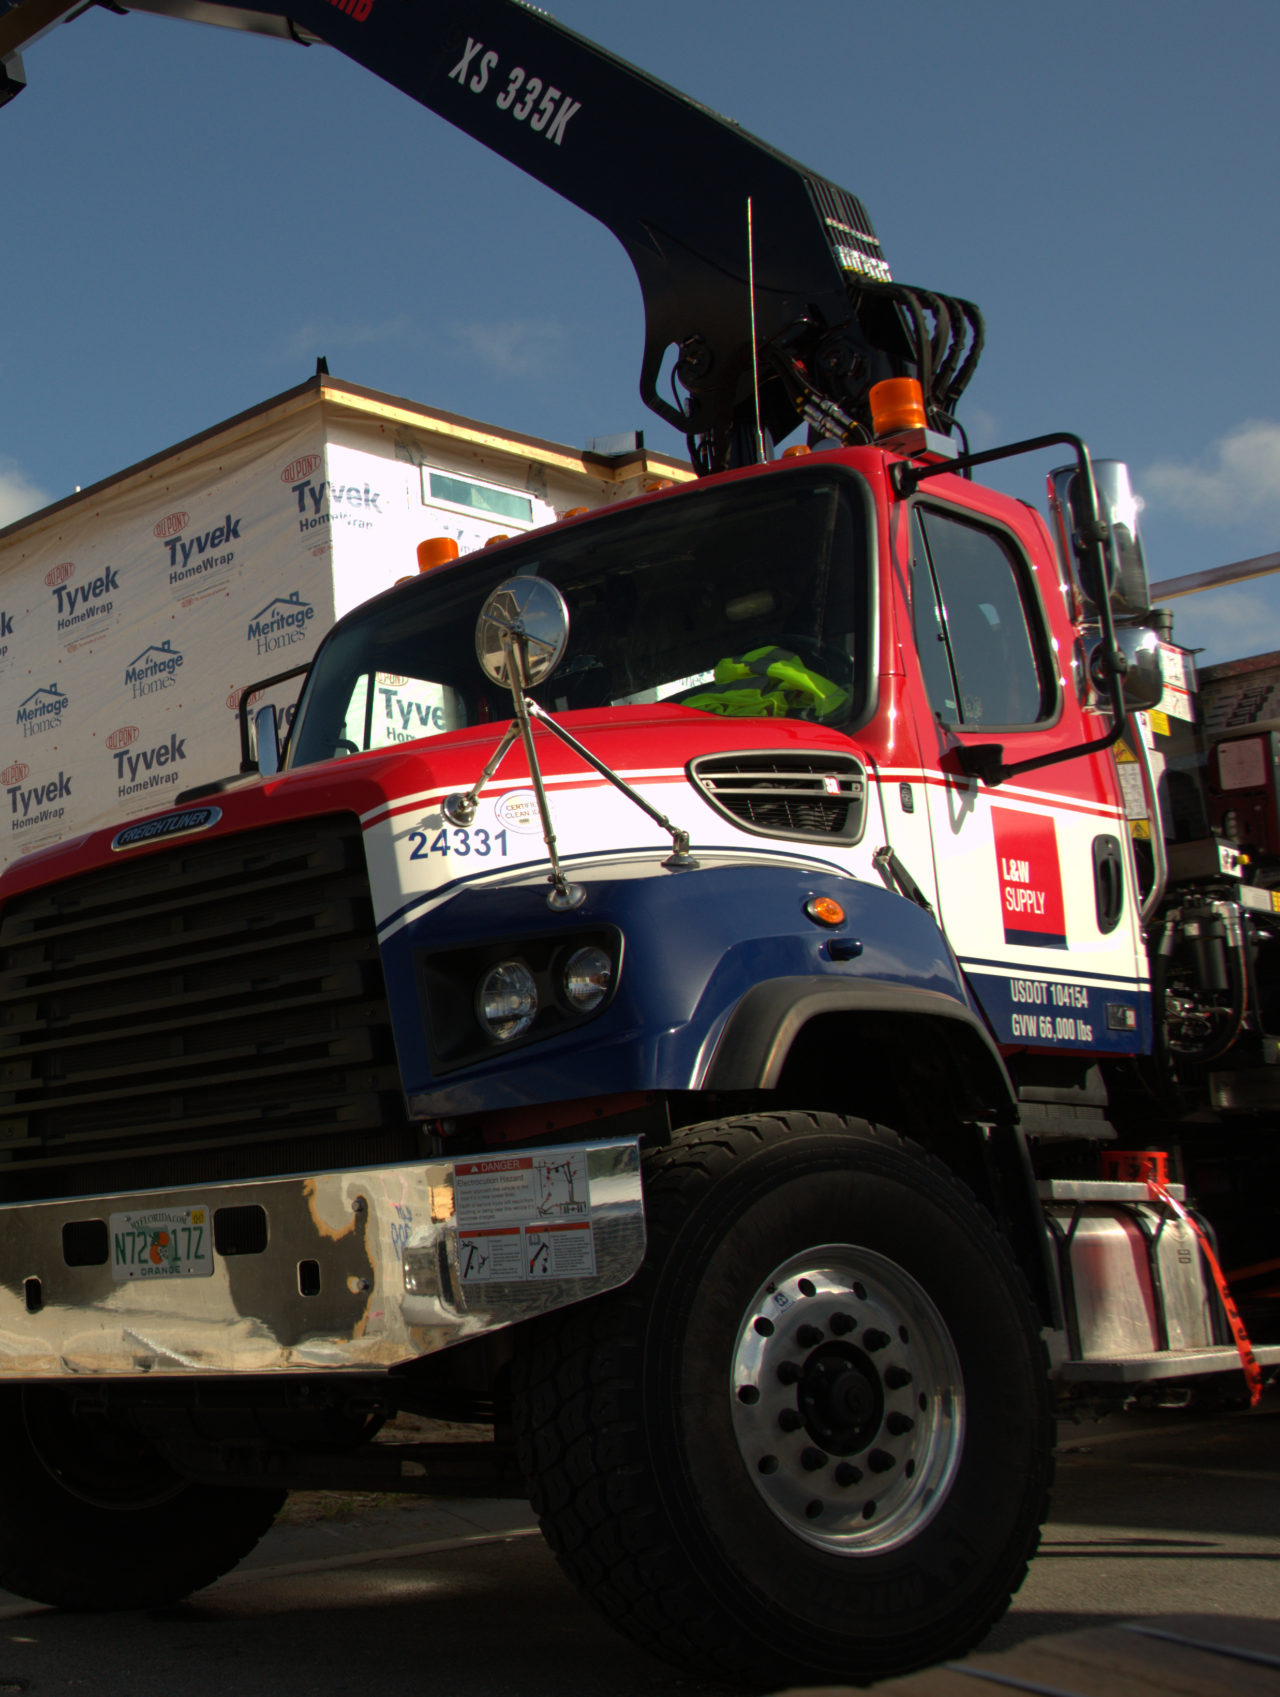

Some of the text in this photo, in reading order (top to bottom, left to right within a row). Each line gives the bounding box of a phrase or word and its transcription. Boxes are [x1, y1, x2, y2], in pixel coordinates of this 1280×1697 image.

[448, 37, 582, 146] XS 335K
[292, 480, 382, 514] Tyvek
[164, 514, 242, 568] Tyvek
[169, 552, 234, 585] HomeWrap
[52, 566, 120, 616] Tyvek
[57, 601, 113, 631] HomeWrap
[247, 605, 314, 641] Meritage
[256, 628, 306, 656] Homes
[124, 654, 184, 686] Meritage
[132, 674, 176, 699] Homes
[16, 696, 69, 725] Meritage
[378, 687, 448, 731] Tyve
[23, 714, 63, 738] Homes
[113, 733, 188, 783] Tyvek
[7, 771, 73, 817] Tyvek
[118, 771, 179, 798] HomeWrap
[12, 807, 65, 831] HomeWrap
[505, 802, 538, 812] CERTIFIE
[120, 810, 208, 844] FREIGHTLINER
[408, 828, 508, 861] 24331
[1002, 857, 1030, 883] L&W
[1005, 886, 1045, 915] SUPPLY
[1010, 979, 1089, 1008] USDOT 104154
[1011, 1013, 1093, 1043] GVW 66,000 lbs
[481, 1159, 521, 1172] DANGER
[114, 1231, 149, 1266] N72
[140, 1265, 182, 1276] ORANGE
